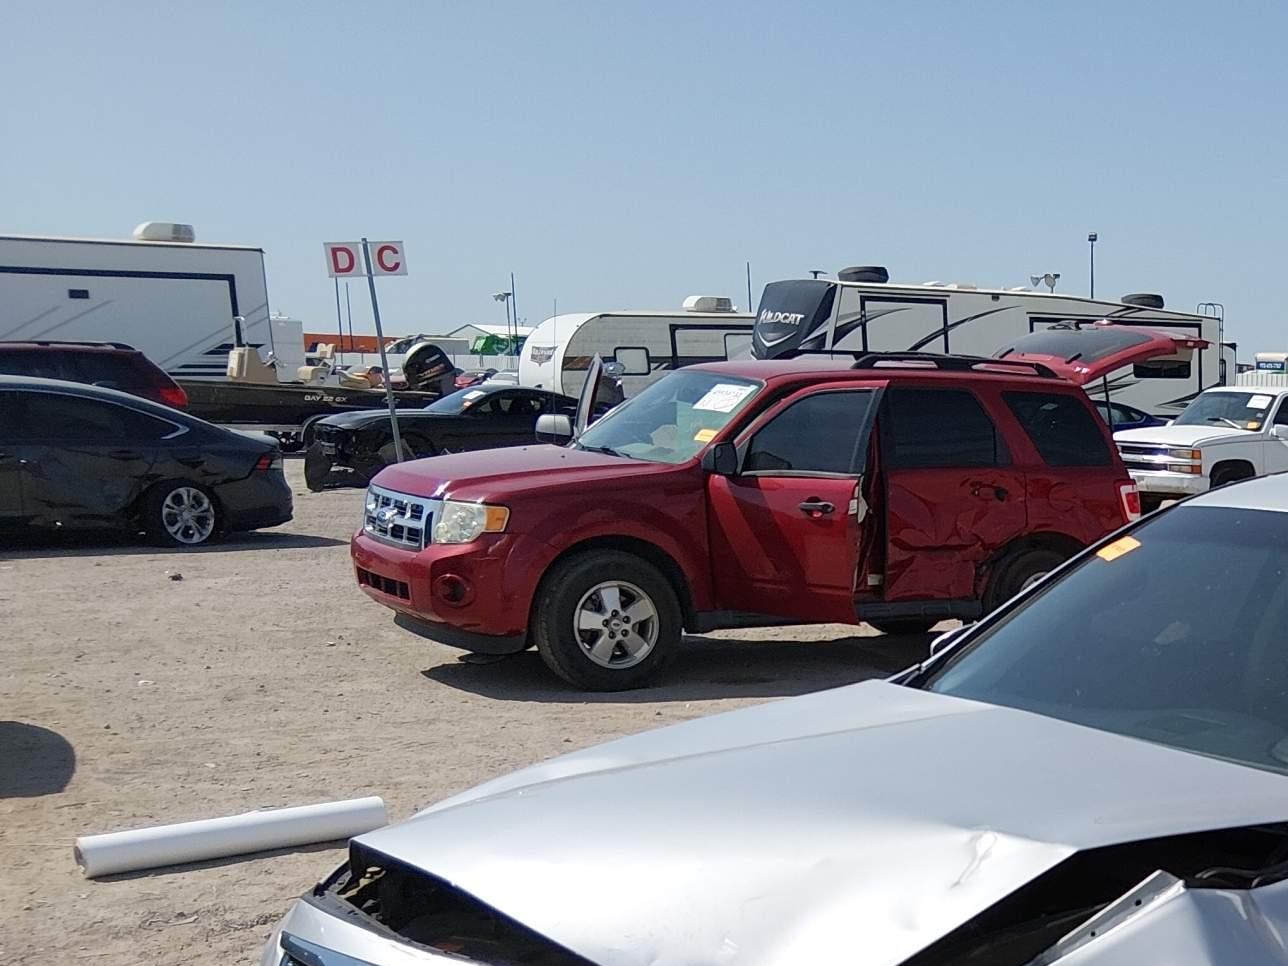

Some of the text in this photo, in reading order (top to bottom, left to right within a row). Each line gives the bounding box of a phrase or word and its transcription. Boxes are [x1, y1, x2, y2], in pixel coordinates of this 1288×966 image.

[331, 246, 355, 274] D
[377, 244, 401, 273] C
[760, 308, 805, 326] WILDCAT
